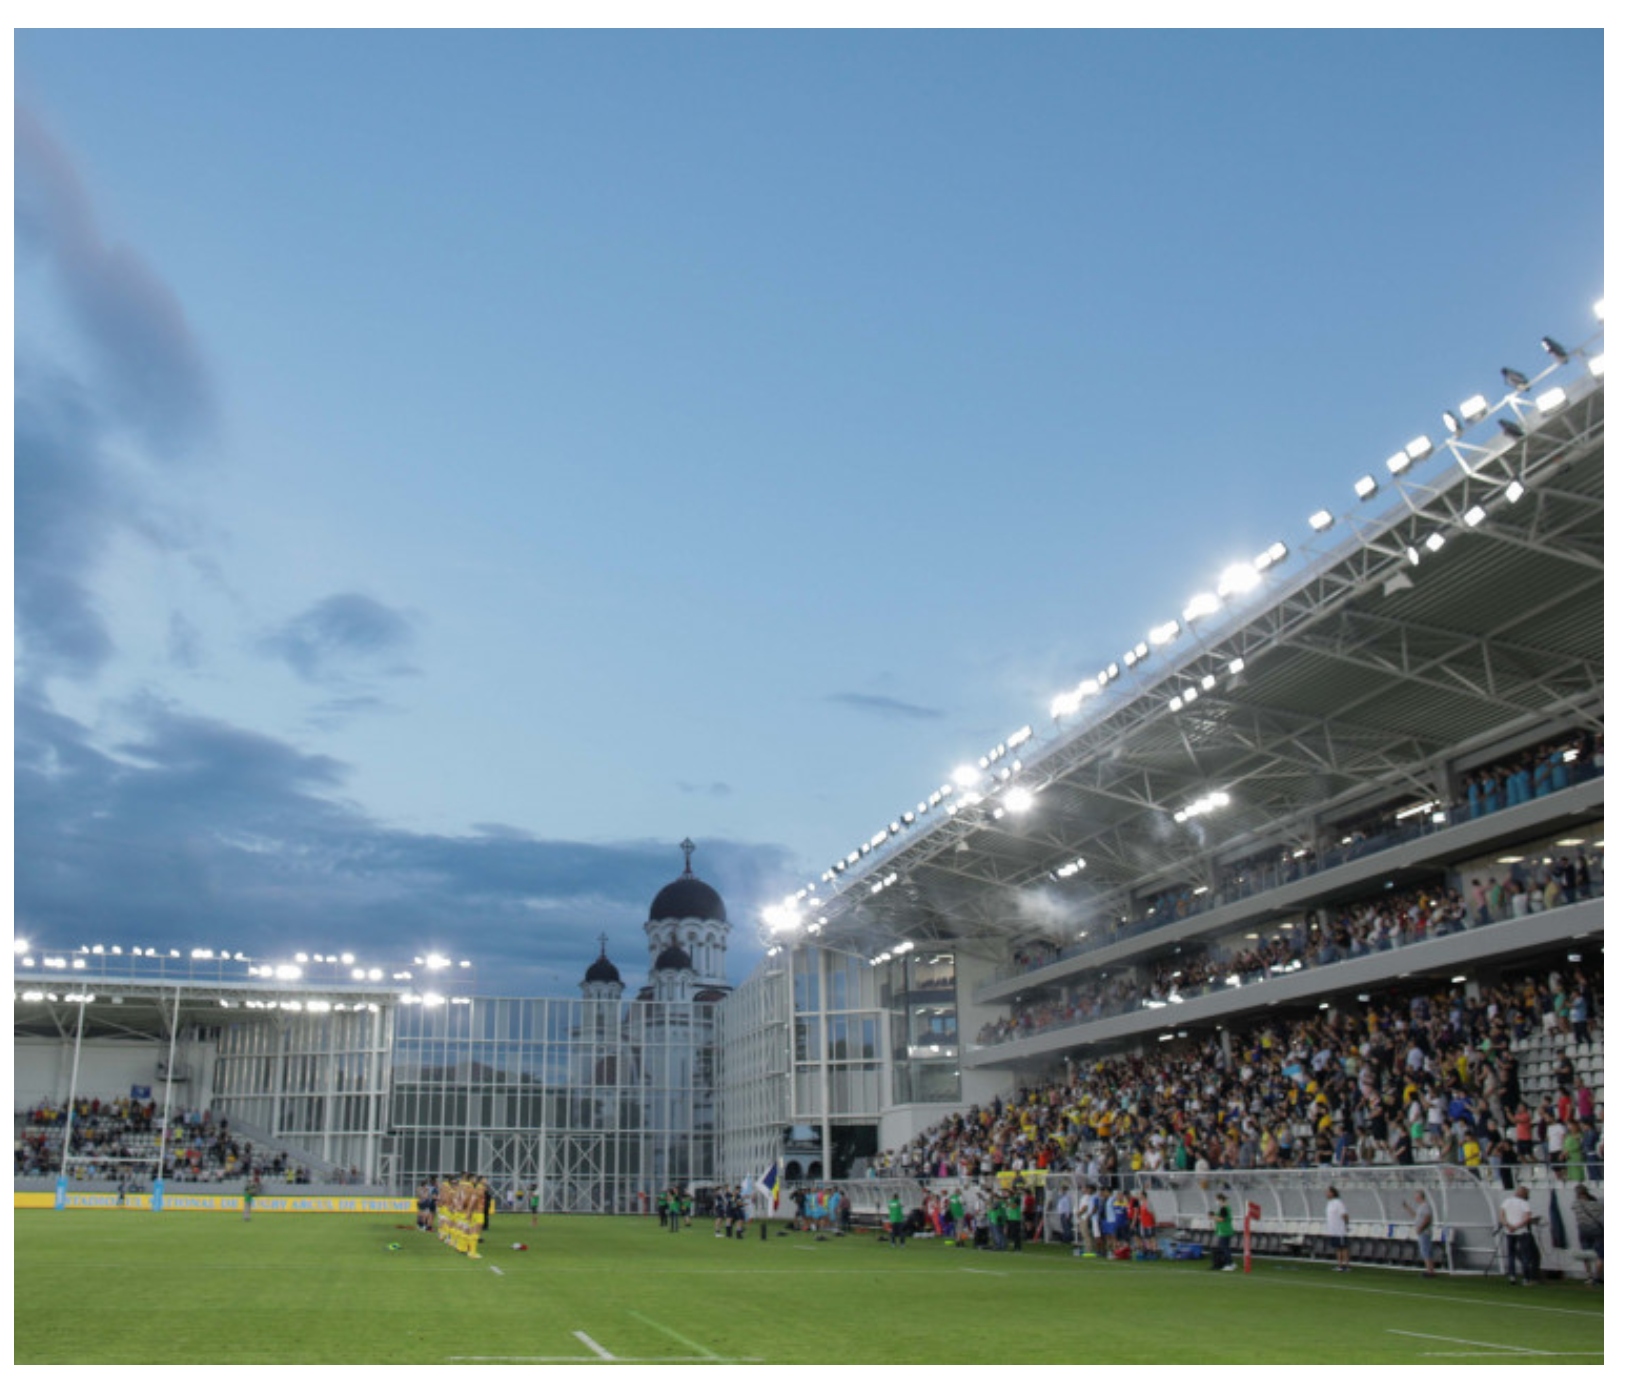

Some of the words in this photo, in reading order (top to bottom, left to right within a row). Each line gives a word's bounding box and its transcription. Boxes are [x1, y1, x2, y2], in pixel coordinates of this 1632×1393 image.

[64, 1195, 141, 1207] STADIOUL
[221, 1198, 237, 1209] DE
[245, 1198, 287, 1210] UGBY
[339, 1198, 354, 1211] DE
